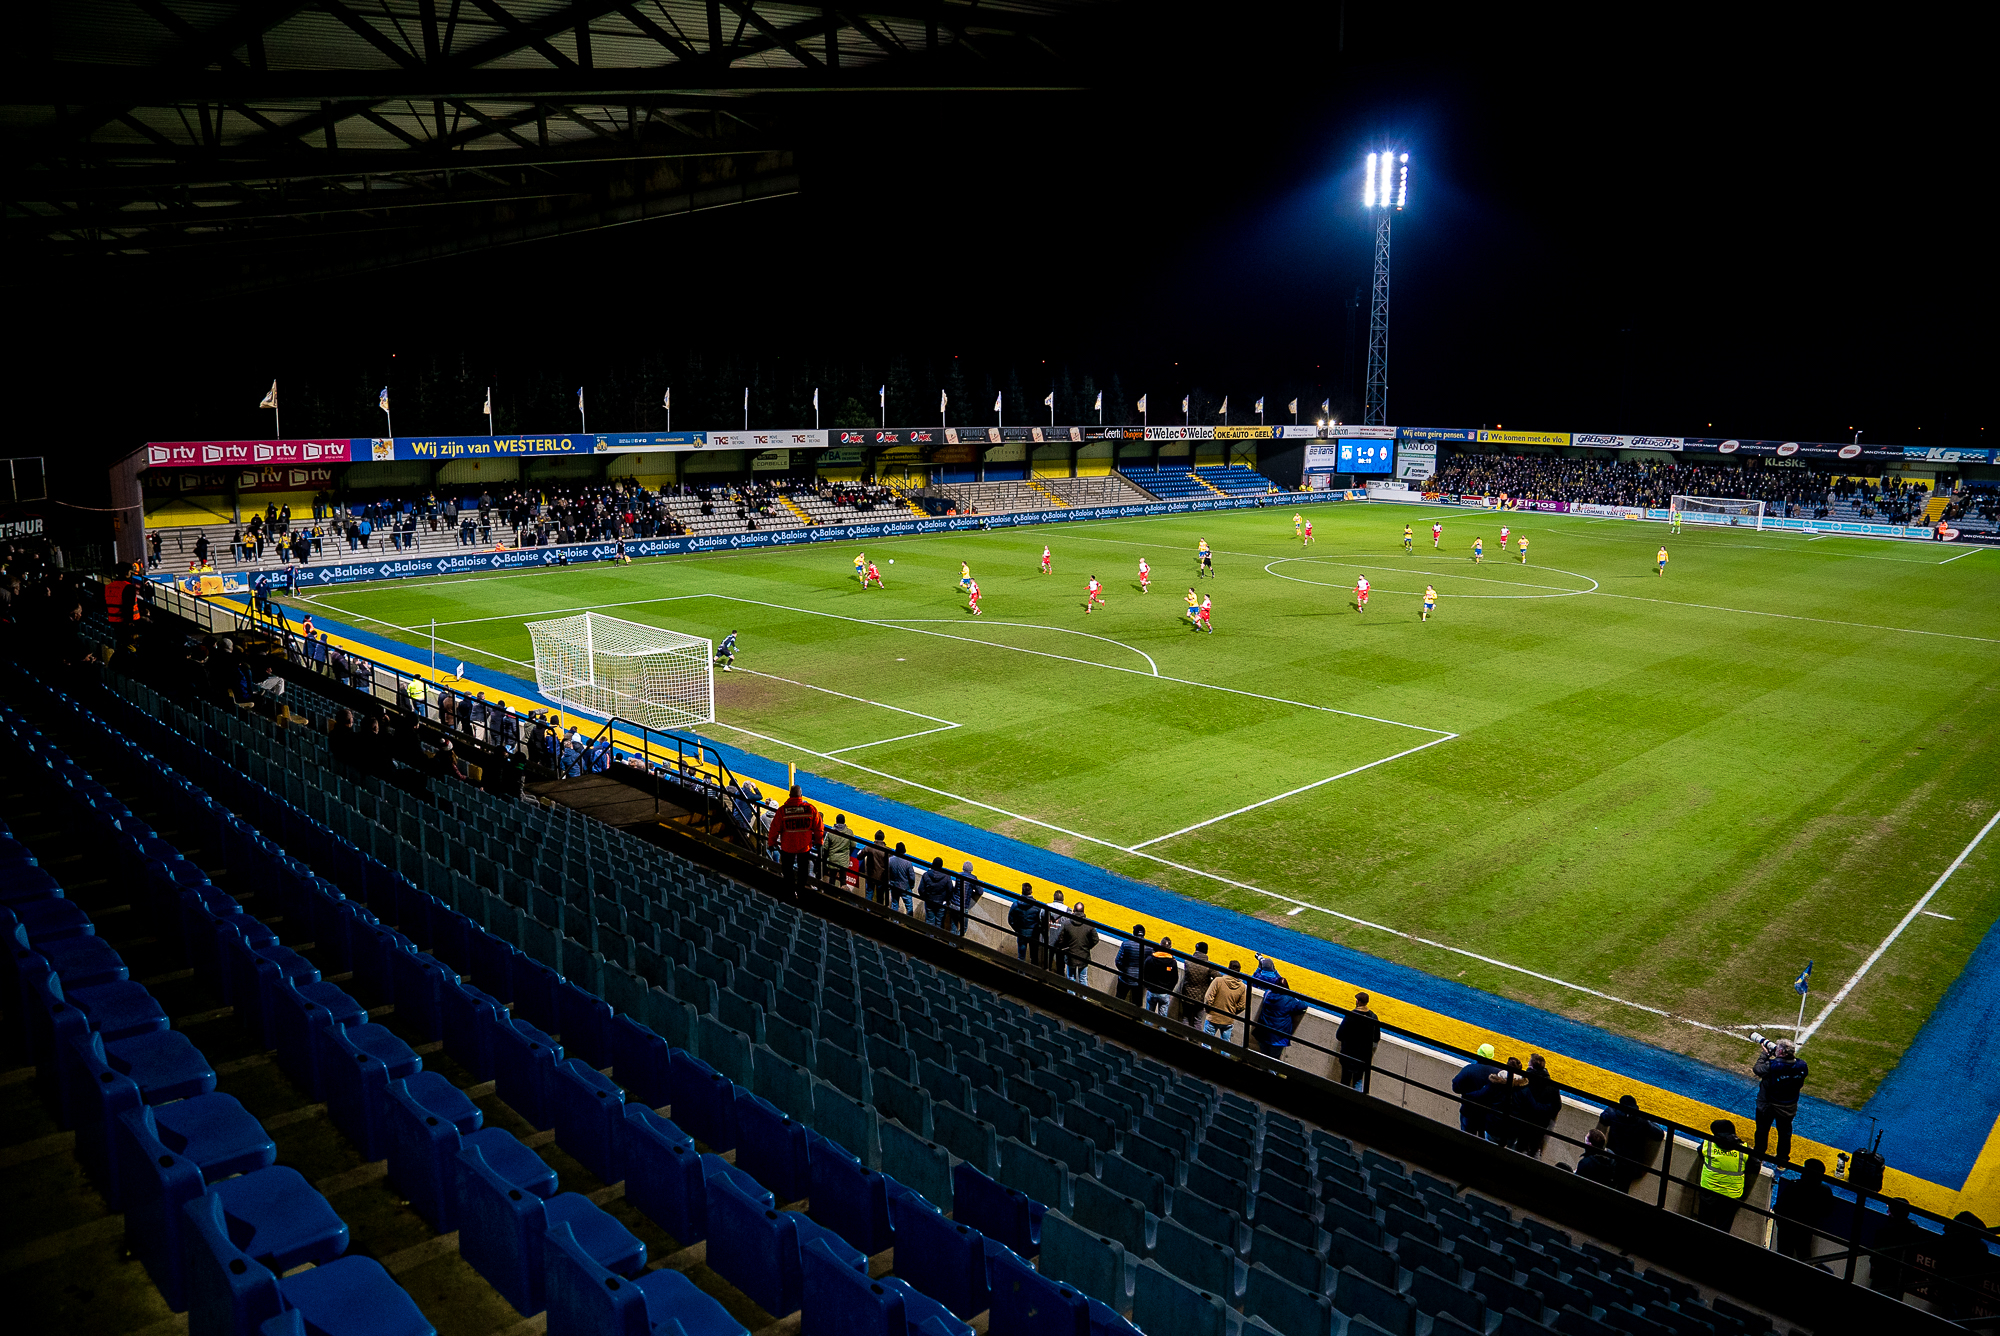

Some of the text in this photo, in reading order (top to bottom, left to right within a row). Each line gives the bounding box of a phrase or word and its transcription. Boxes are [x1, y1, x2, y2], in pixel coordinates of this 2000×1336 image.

[1003, 428, 1028, 436] PRIMUS
[1152, 428, 1180, 439] Welec
[1187, 427, 1212, 438] Welec
[1402, 429, 1413, 438] Wij
[1427, 430, 1442, 439] geire
[1443, 432, 1465, 440] pensen.
[713, 436, 729, 446] TKE
[753, 435, 768, 445] TKE
[792, 434, 806, 443] TKE
[173, 446, 195, 459] rtv
[226, 445, 247, 457] rtv
[276, 444, 297, 456] rtv
[324, 442, 344, 455] rtv
[411, 439, 576, 458] Wij zijn van WESTERLO.
[1925, 448, 1961, 461] KB
[311, 468, 332, 481] rtv
[1020, 512, 1039, 521] Baloise
[1049, 510, 1067, 519] Baloise
[1076, 508, 1094, 517] Baloise
[925, 519, 947, 528] Baloise
[957, 517, 979, 526] Baloise
[990, 514, 1011, 524] Baloise
[820, 527, 845, 537] Baloise
[856, 524, 880, 534] Baloise
[892, 522, 914, 531] Baloise
[741, 533, 768, 543] Baloise
[781, 530, 808, 540] Baloise
[650, 540, 681, 551] Baloise
[698, 536, 728, 547] Baloise
[604, 544, 636, 554] Balse
[450, 556, 487, 567] Baloise
[504, 552, 539, 563] Baloise
[335, 565, 375, 577] Baloise
[394, 561, 432, 572] Baloise
[272, 570, 315, 583] Baise
